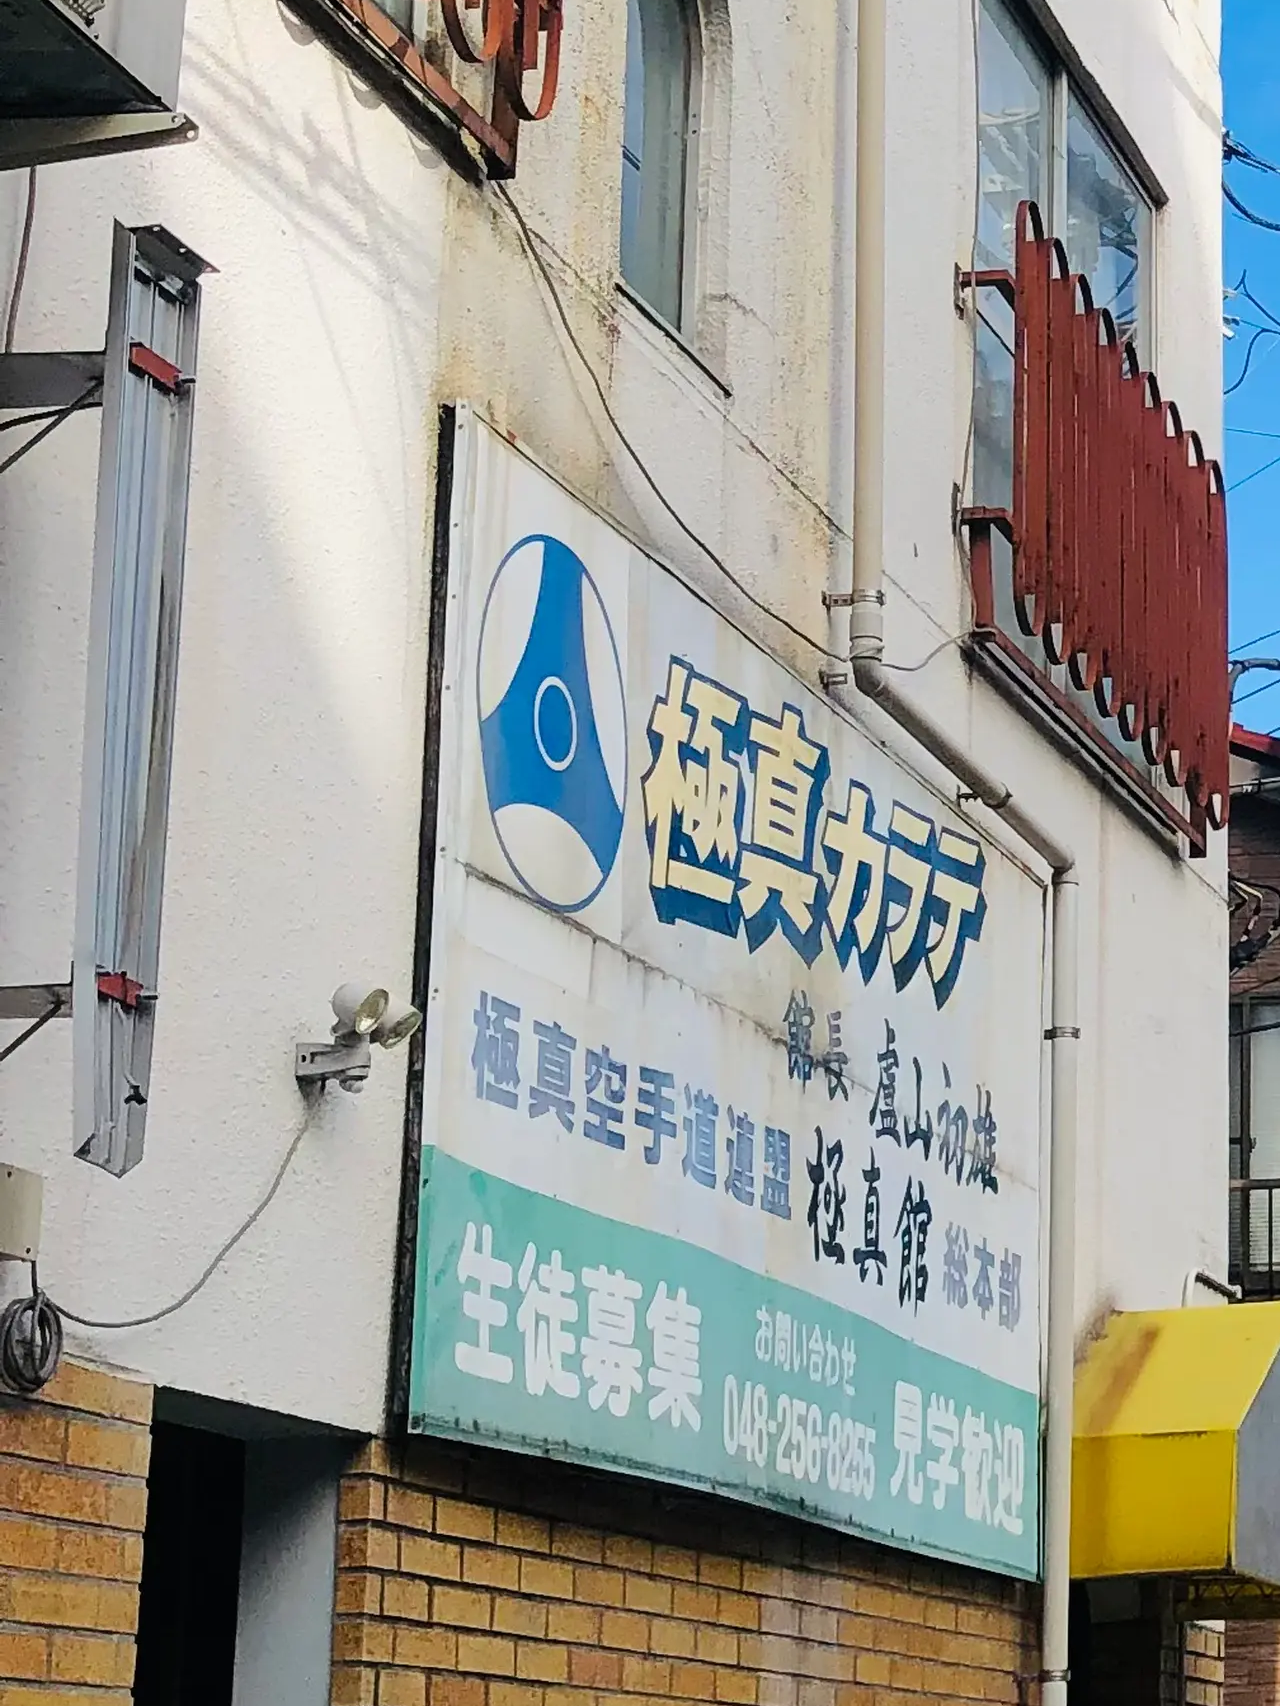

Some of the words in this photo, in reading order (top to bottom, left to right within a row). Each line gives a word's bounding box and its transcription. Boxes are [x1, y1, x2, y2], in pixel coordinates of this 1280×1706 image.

[641, 654, 987, 1011] 極真カラテ
[784, 990, 850, 1101] 館長
[471, 990, 792, 1221] 極真空手道連盟
[806, 1125, 932, 1318] 極真館
[943, 1221, 1022, 1332] 総本部
[454, 1221, 702, 1432] 生徒募集
[755, 1305, 856, 1396] お問い合わせ
[723, 1374, 876, 1501] 048-256-8255
[890, 1380, 1025, 1536] 見学歓迎
